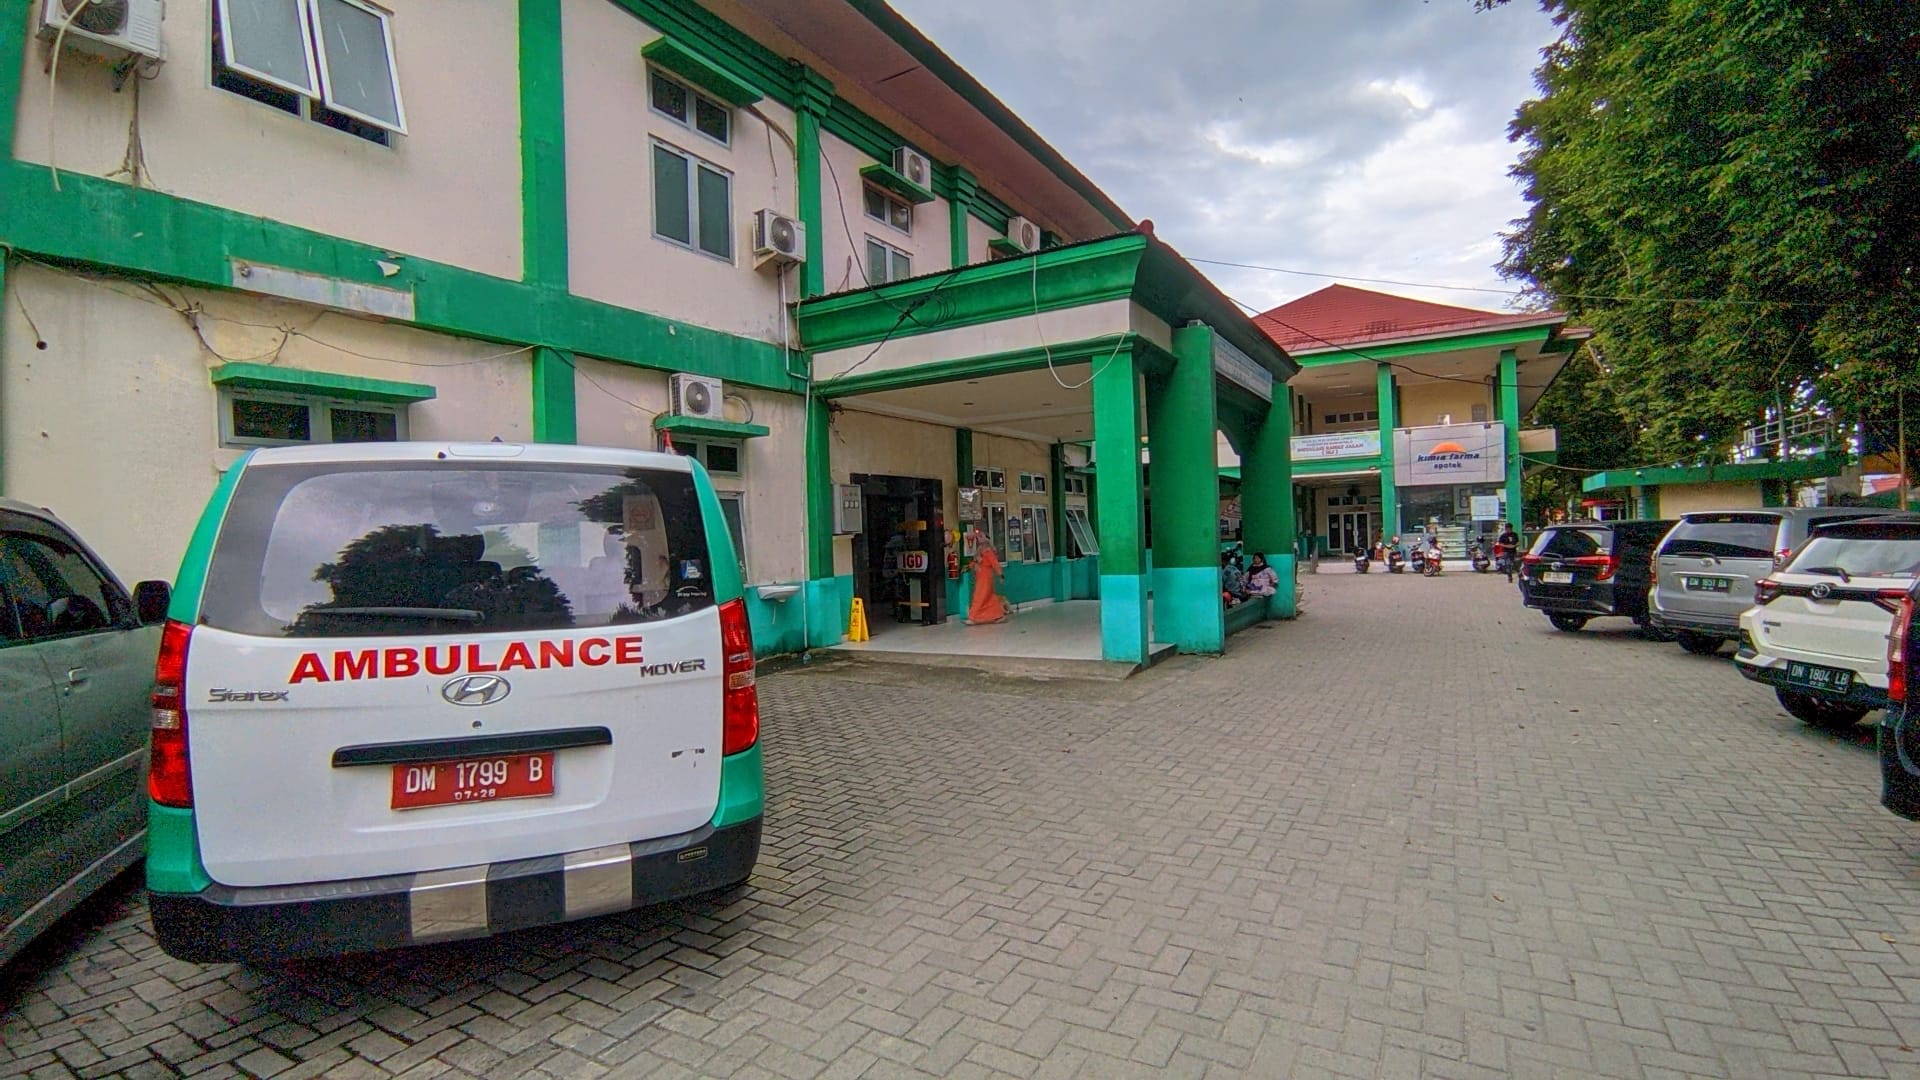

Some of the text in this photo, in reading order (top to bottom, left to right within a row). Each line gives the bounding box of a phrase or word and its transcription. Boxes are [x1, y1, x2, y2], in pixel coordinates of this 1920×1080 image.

[1417, 454, 1446, 462] kimia
[1434, 461, 1461, 469] apotek
[902, 553, 923, 569] IGD
[289, 635, 644, 685] AMBULANCE
[640, 659, 706, 678] MOVER
[1791, 665, 1805, 678] DN
[1809, 668, 1831, 682] 1804
[1834, 672, 1850, 685] LB
[208, 688, 289, 702] Starex
[406, 757, 543, 793] DM 1799 B
